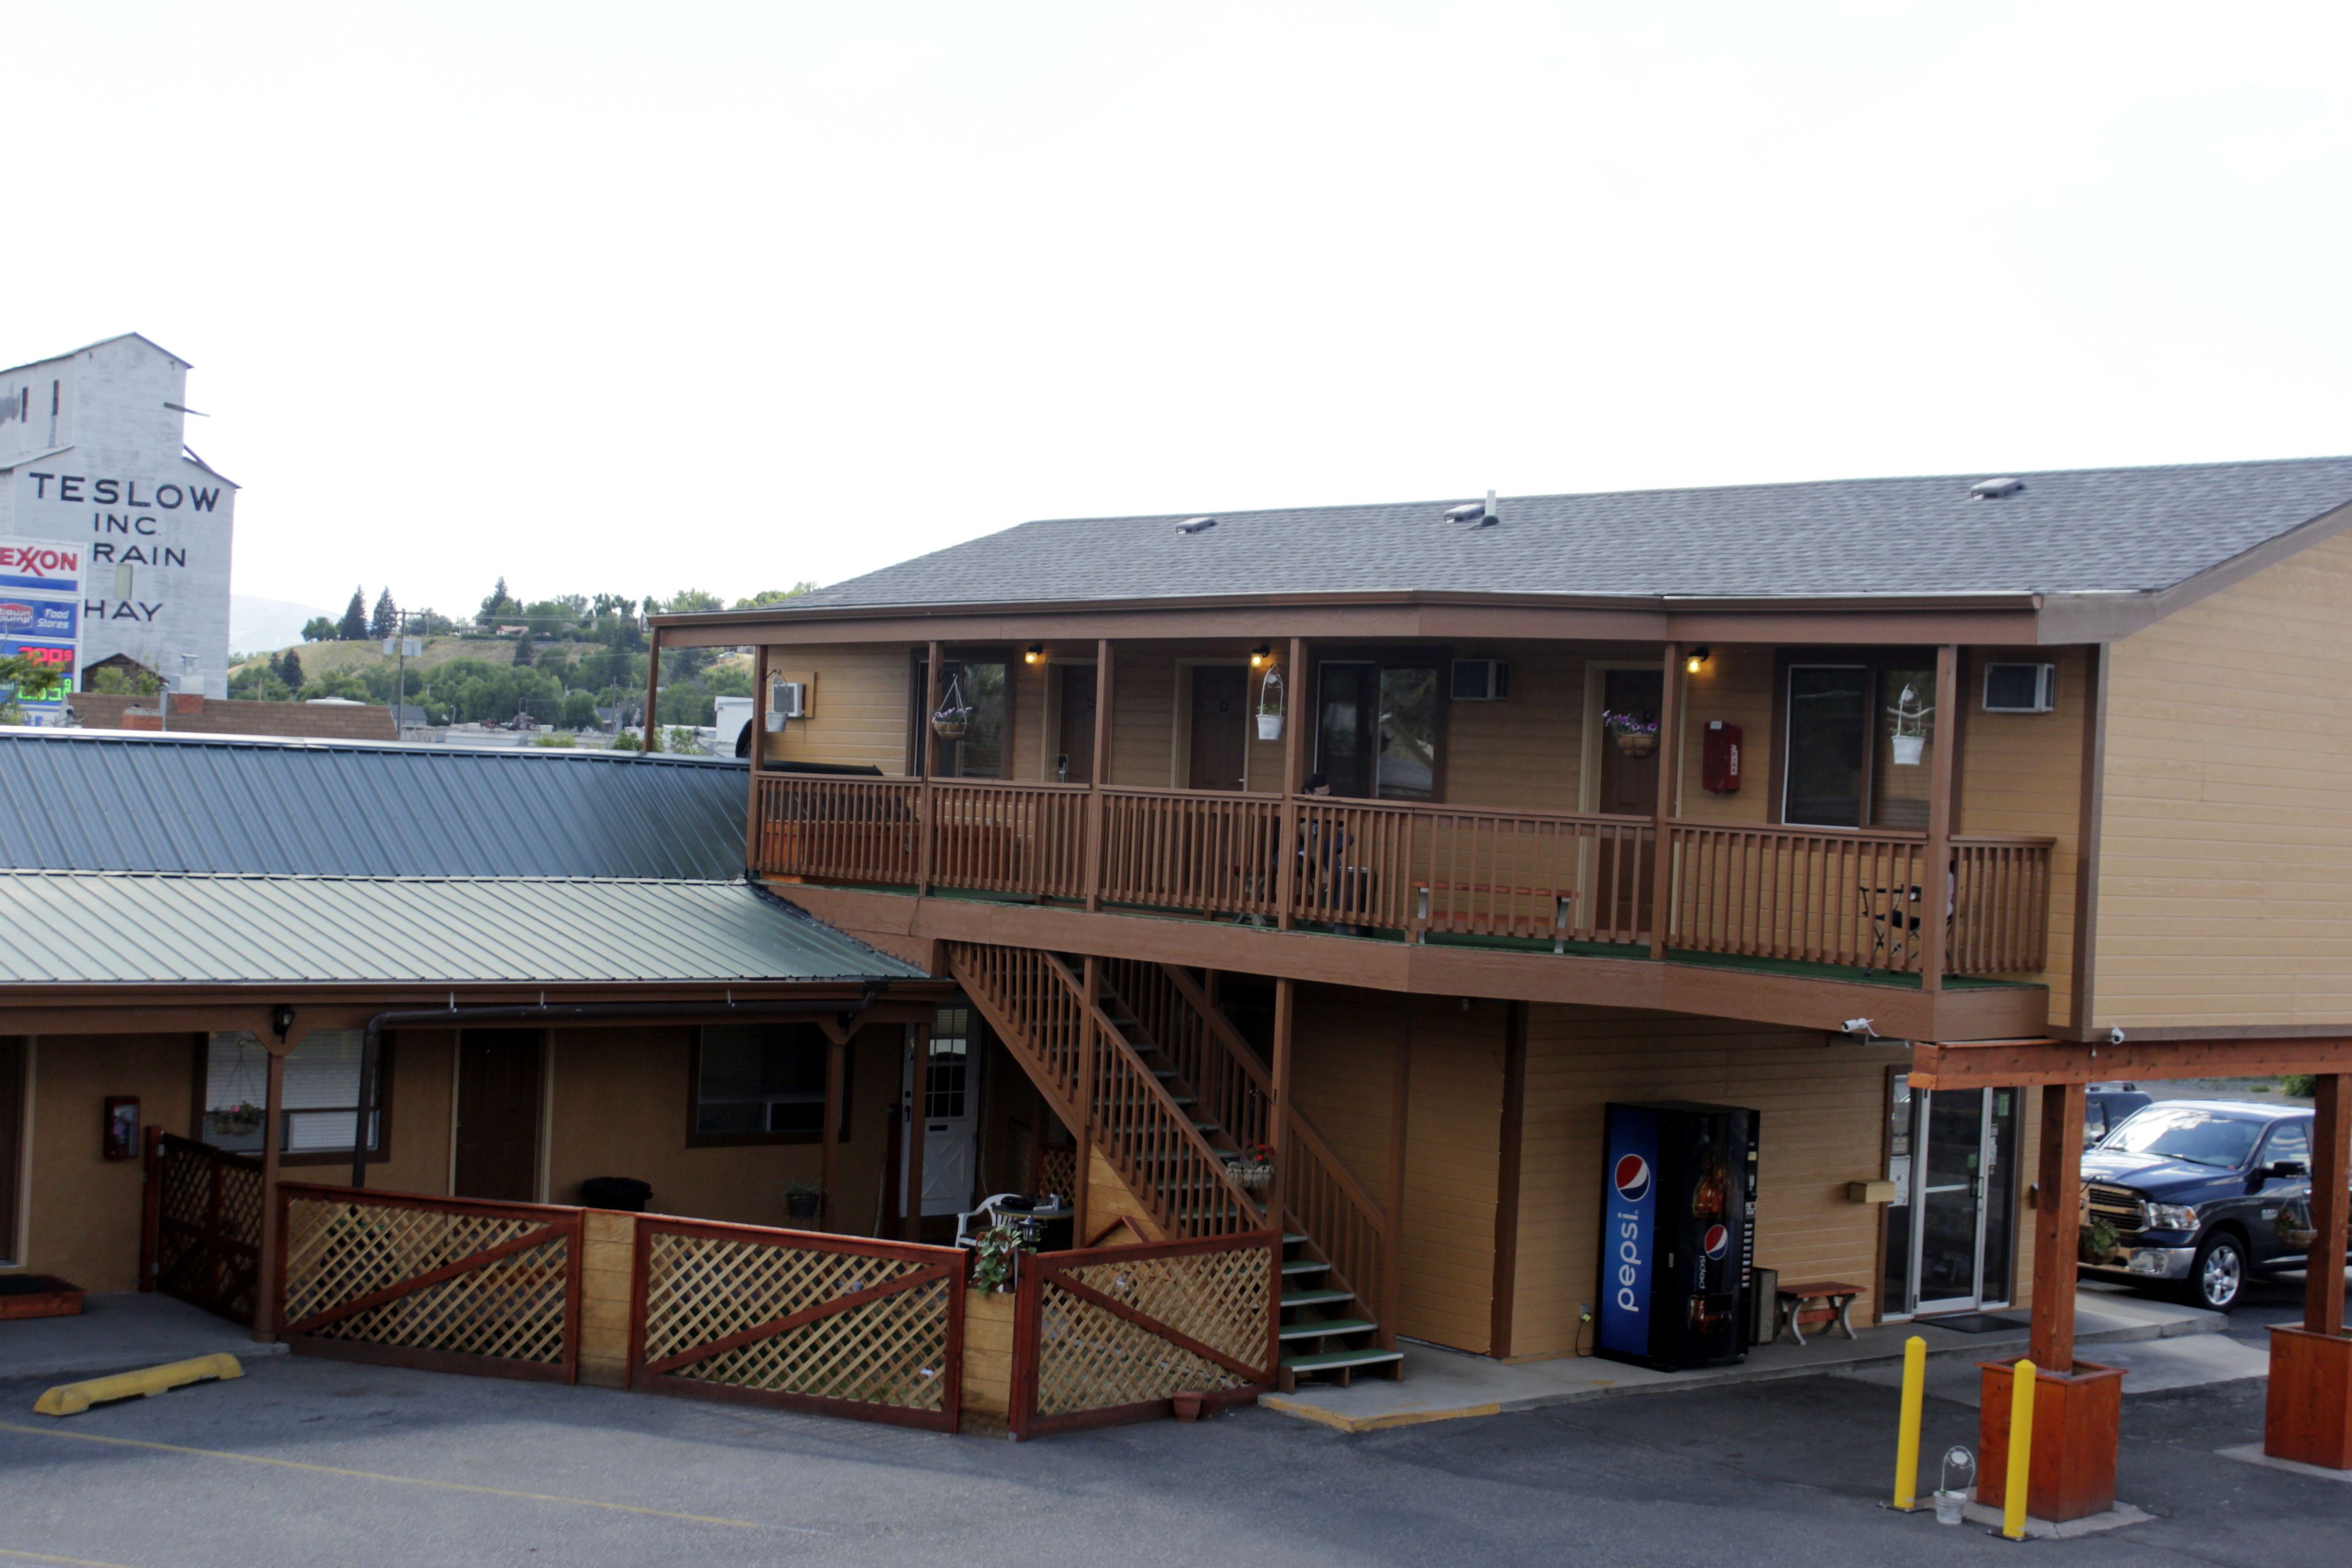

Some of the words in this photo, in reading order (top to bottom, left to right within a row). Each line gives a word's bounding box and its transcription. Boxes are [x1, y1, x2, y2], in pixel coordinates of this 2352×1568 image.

[29, 472, 221, 512] TESLOW
[94, 513, 161, 537] INC.
[0, 546, 78, 577] EXXON
[44, 608, 70, 619] Food
[85, 599, 164, 622] HAY
[37, 617, 70, 629] Stores
[1617, 1211, 1642, 1313] pepsi
